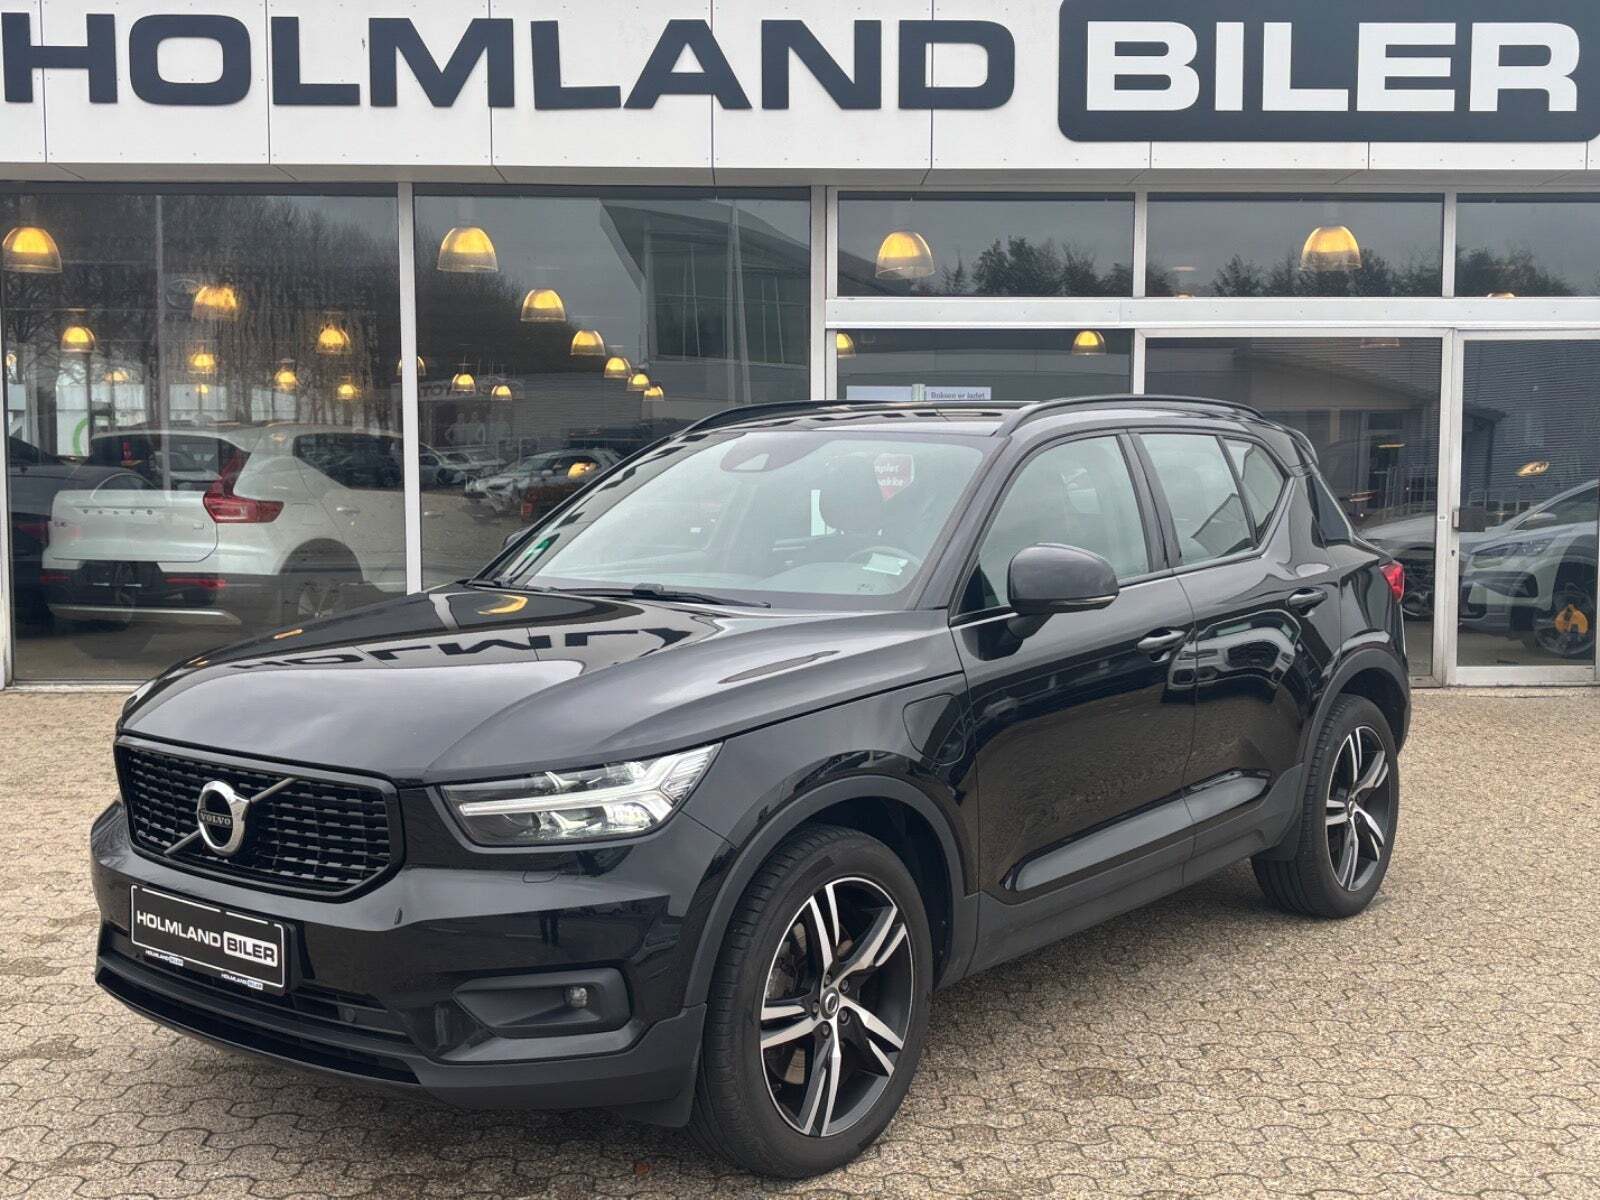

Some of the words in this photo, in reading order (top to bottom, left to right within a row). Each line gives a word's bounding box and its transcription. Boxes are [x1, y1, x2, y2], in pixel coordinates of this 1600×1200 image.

[2, 13, 1014, 111] HOLMLAND
[1086, 20, 1580, 112] BILER
[200, 812, 231, 825] VOLVO
[136, 910, 221, 948] HOLMLAND
[227, 937, 275, 962] BILER
